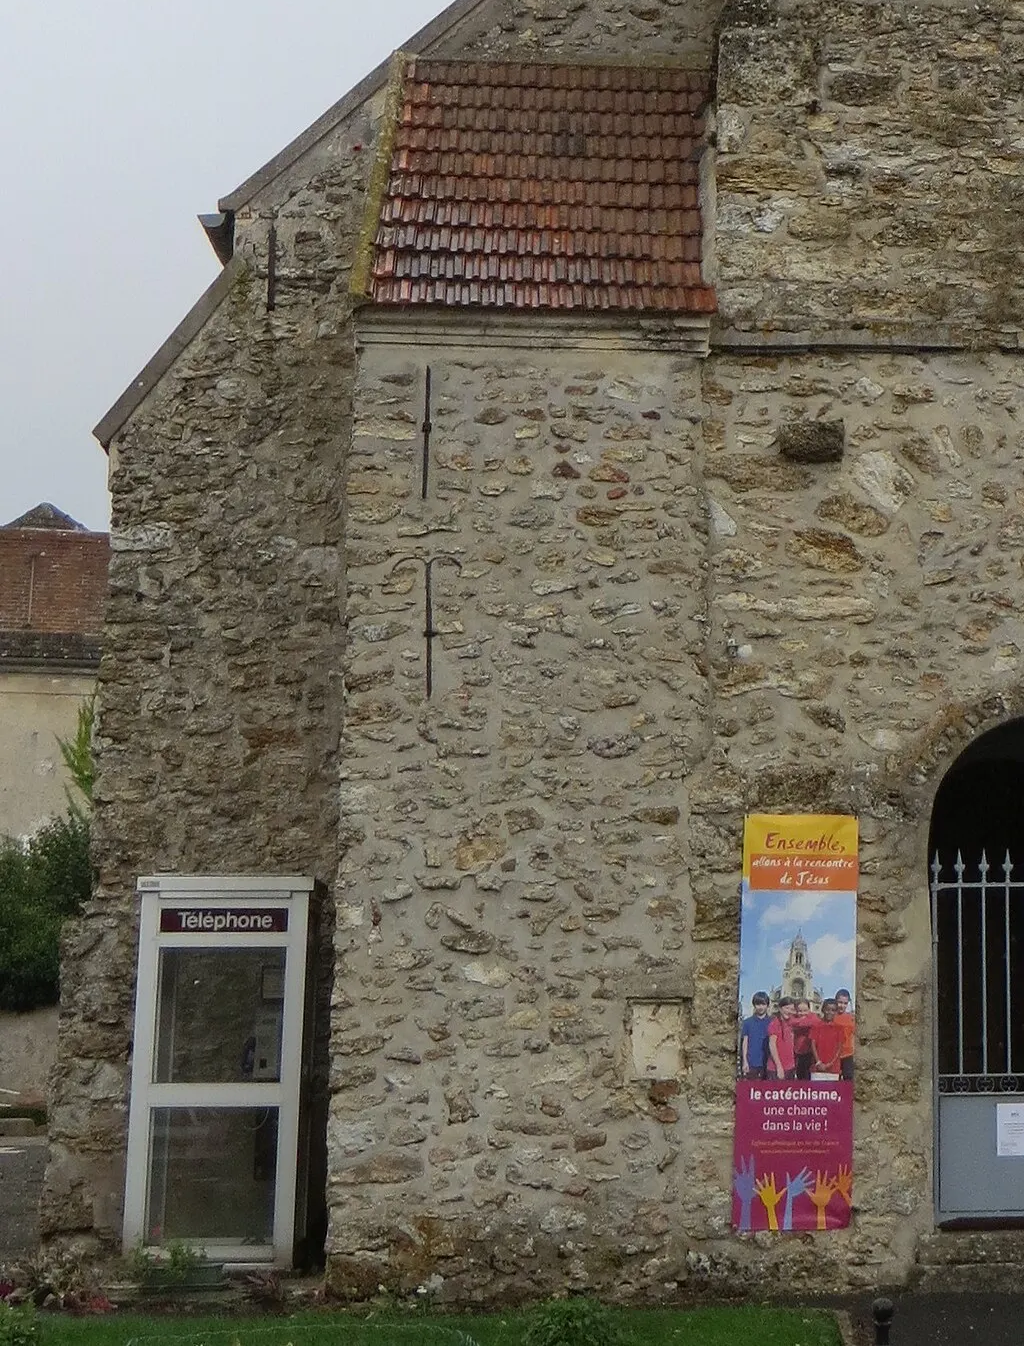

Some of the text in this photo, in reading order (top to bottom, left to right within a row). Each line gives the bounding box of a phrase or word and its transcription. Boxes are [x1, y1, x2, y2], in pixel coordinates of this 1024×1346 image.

[765, 832, 846, 853] Ensemble,
[752, 856, 854, 868] allons à la rencontre
[780, 871, 829, 886] de Jésus
[178, 911, 273, 931] Téléphone
[750, 1087, 841, 1102] le catéchisme,
[763, 1104, 828, 1116] une chance
[762, 1119, 790, 1131] dans
[792, 1119, 803, 1131] la
[805, 1119, 821, 1131] vie
